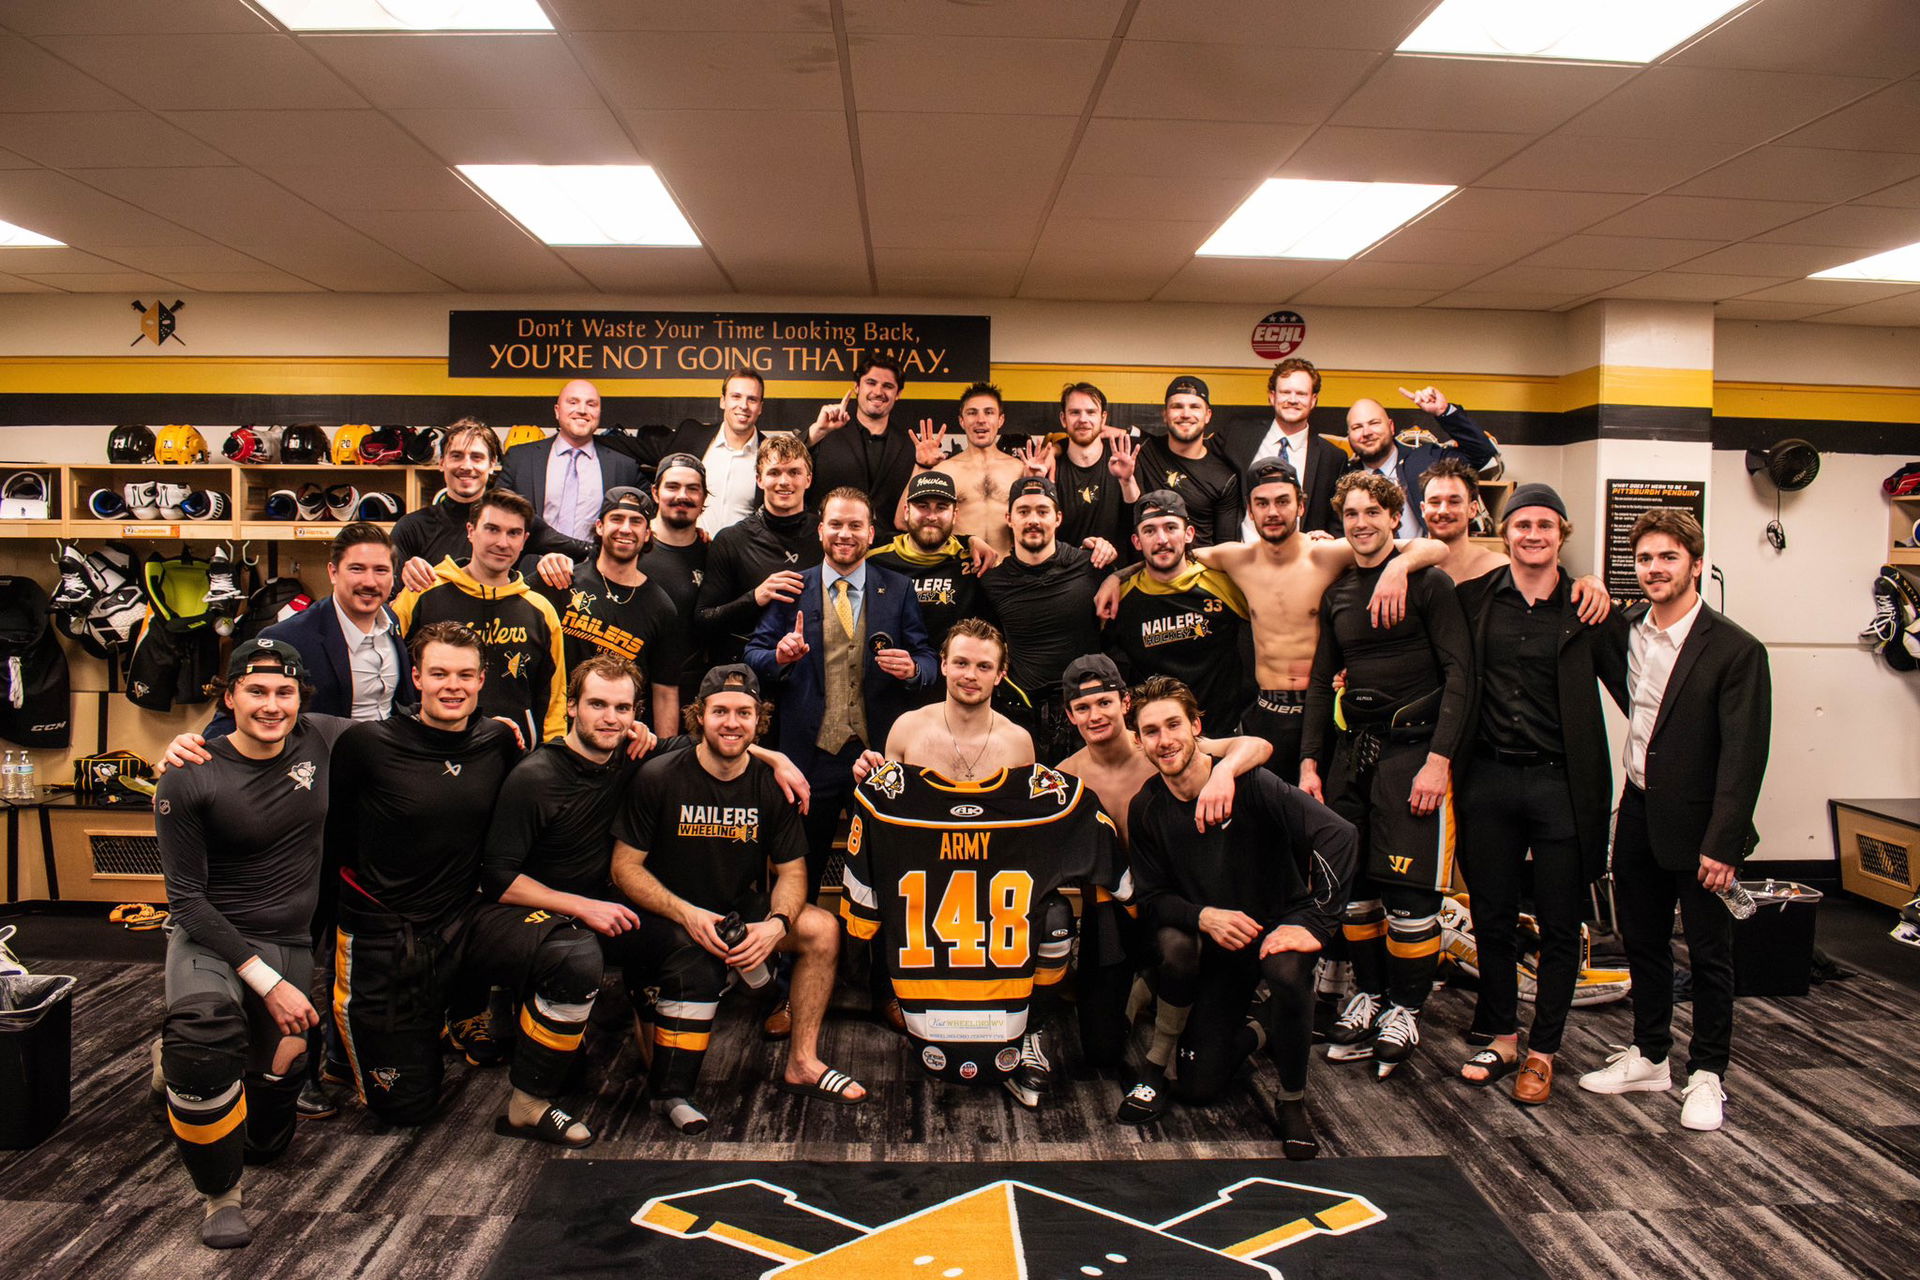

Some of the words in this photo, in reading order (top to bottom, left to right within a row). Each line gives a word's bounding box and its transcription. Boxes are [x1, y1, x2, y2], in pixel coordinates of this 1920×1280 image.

[518, 318, 574, 337] Don't
[581, 318, 646, 338] Waste
[655, 319, 704, 339] Your
[713, 319, 764, 340] Time
[772, 320, 856, 347] Looking
[864, 321, 920, 343] Back,
[1253, 326, 1302, 342] ECHL
[489, 343, 593, 369] YOU'RE
[603, 345, 668, 370] NOT
[677, 345, 772, 371] GOING
[782, 347, 865, 372] THAT
[341, 439, 351, 449] 20
[917, 477, 949, 487] Howies
[1612, 488, 1660, 496] PITTSBURGH
[1203, 598, 1223, 613] 33
[1142, 611, 1204, 636] NAILERS
[561, 610, 645, 654] NAILERS
[1143, 628, 1192, 645] HOCKEY
[31, 720, 67, 732] CCM
[680, 804, 759, 826] NAILERS
[680, 824, 737, 837] WHEELING
[847, 814, 863, 856] 8
[939, 831, 991, 860] ARMY
[898, 870, 1034, 968] 148
[923, 1051, 945, 1061] Great
[926, 1058, 944, 1068] Clips
